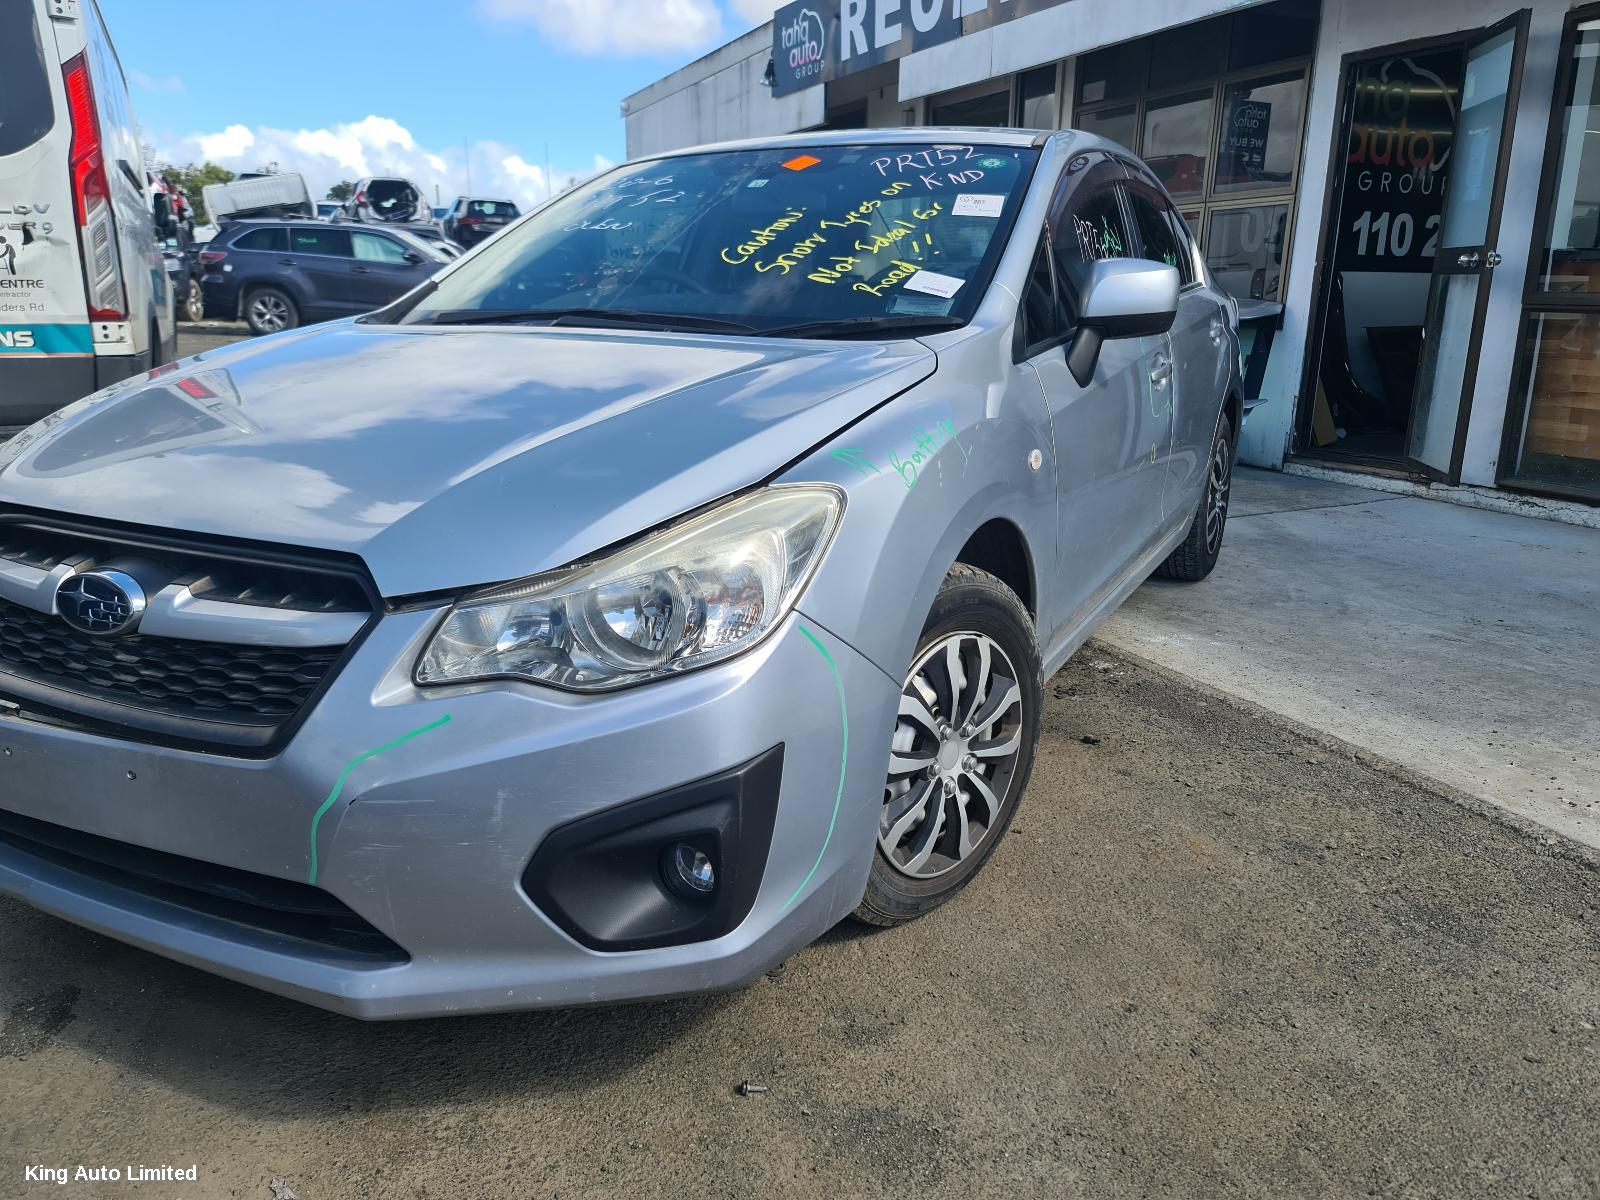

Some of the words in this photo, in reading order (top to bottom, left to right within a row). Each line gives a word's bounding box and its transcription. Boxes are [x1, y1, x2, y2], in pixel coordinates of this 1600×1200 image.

[781, 17, 809, 50] taha
[789, 40, 817, 68] auto
[796, 60, 825, 79] GROUP
[869, 145, 985, 177] PRT52
[880, 182, 912, 195] on
[42, 222, 54, 235] 9
[1352, 210, 1415, 258] 110
[807, 256, 861, 284] Not
[29, 302, 45, 312] Rd
